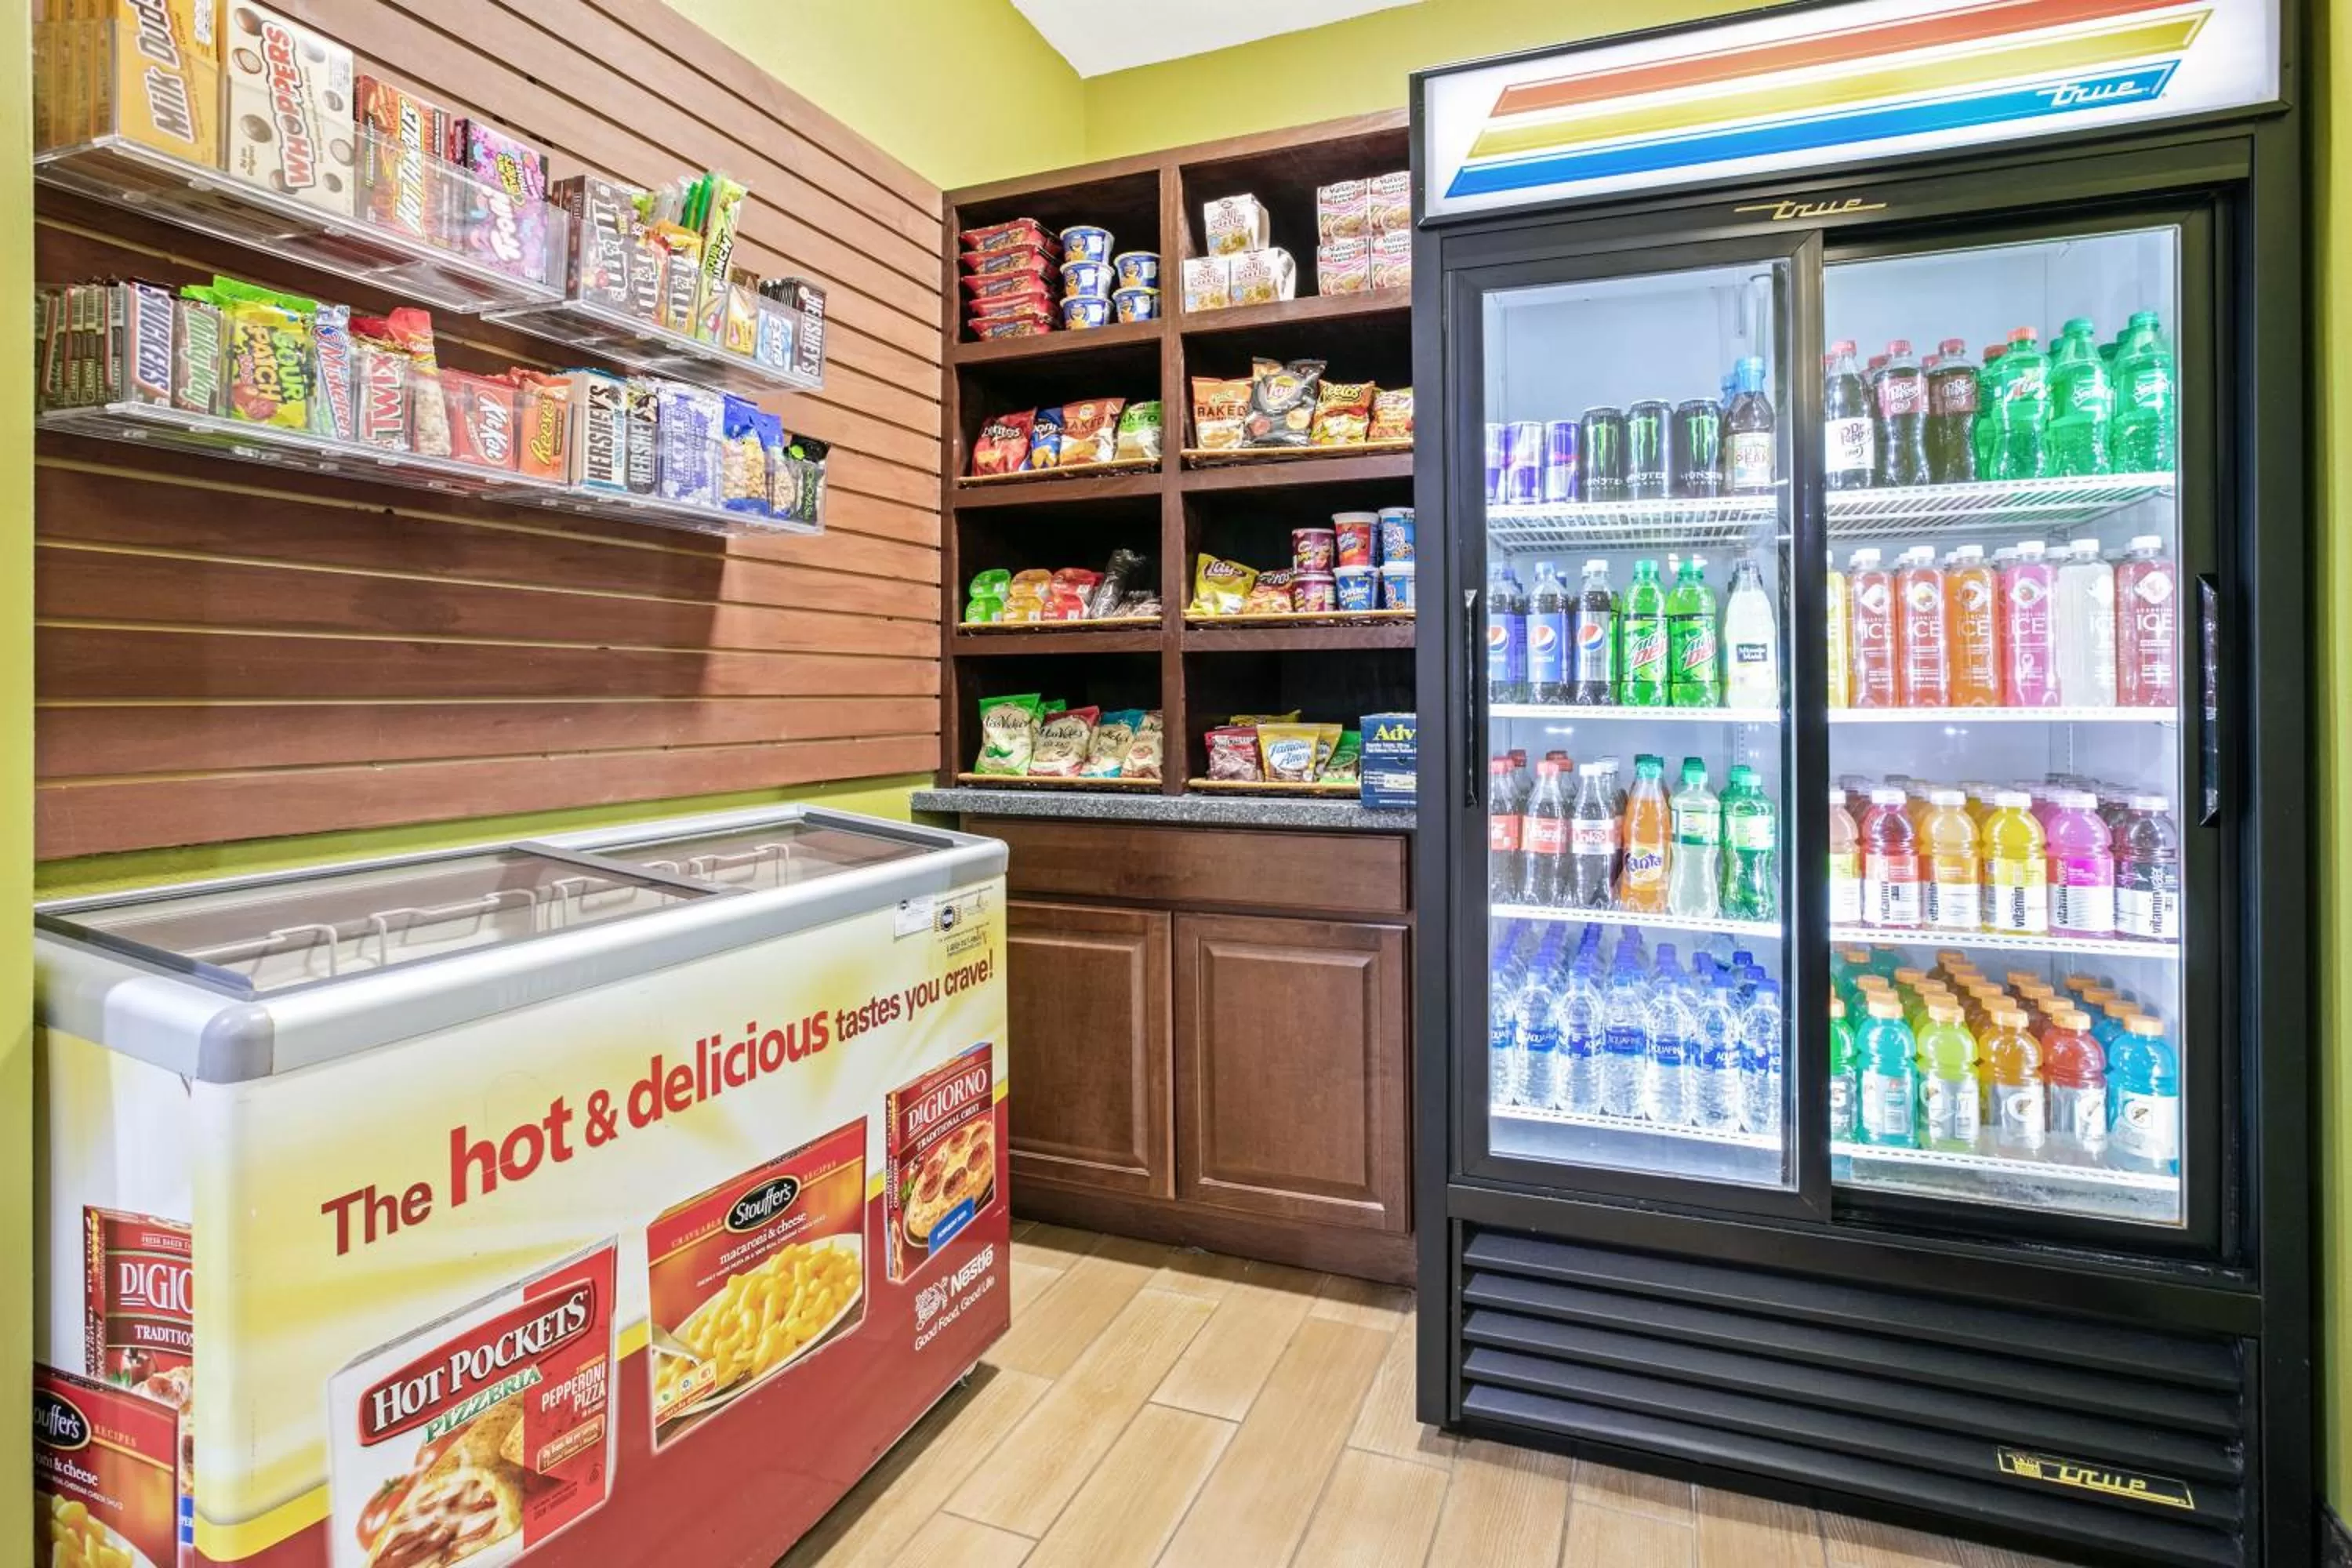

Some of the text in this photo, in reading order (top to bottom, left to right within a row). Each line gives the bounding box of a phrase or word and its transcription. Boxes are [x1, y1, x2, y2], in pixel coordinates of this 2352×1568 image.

[263, 23, 314, 187] WHOPPERS
[138, 285, 170, 391] SNICKERS
[248, 325, 282, 402] PATCH
[800, 296, 824, 378] HERSHEY'S
[272, 331, 306, 402] SOUR
[365, 353, 402, 438] TWIX
[1197, 404, 1248, 418] BAKED
[589, 383, 613, 481] HERSHEY'S
[982, 426, 1022, 441] Doritos
[2136, 614, 2173, 631] ICE
[1374, 724, 1416, 742] Adv
[321, 947, 994, 1257] The hot & delicious tastes you crave!
[734, 1182, 792, 1226] Stouffer's
[719, 1231, 768, 1265] macaroni
[777, 1211, 807, 1236] cheese
[119, 1262, 194, 1314] DIGIO
[134, 1324, 194, 1347] TRADITION
[372, 1291, 587, 1433] HOT POCKETS
[424, 1363, 543, 1445] PIZZERIA
[541, 1360, 606, 1413] PEPPERONI
[573, 1380, 606, 1413] PIZZA
[34, 1404, 81, 1439] ouffer's
[93, 1424, 137, 1448] RECIPES
[64, 1458, 99, 1486] cheese
